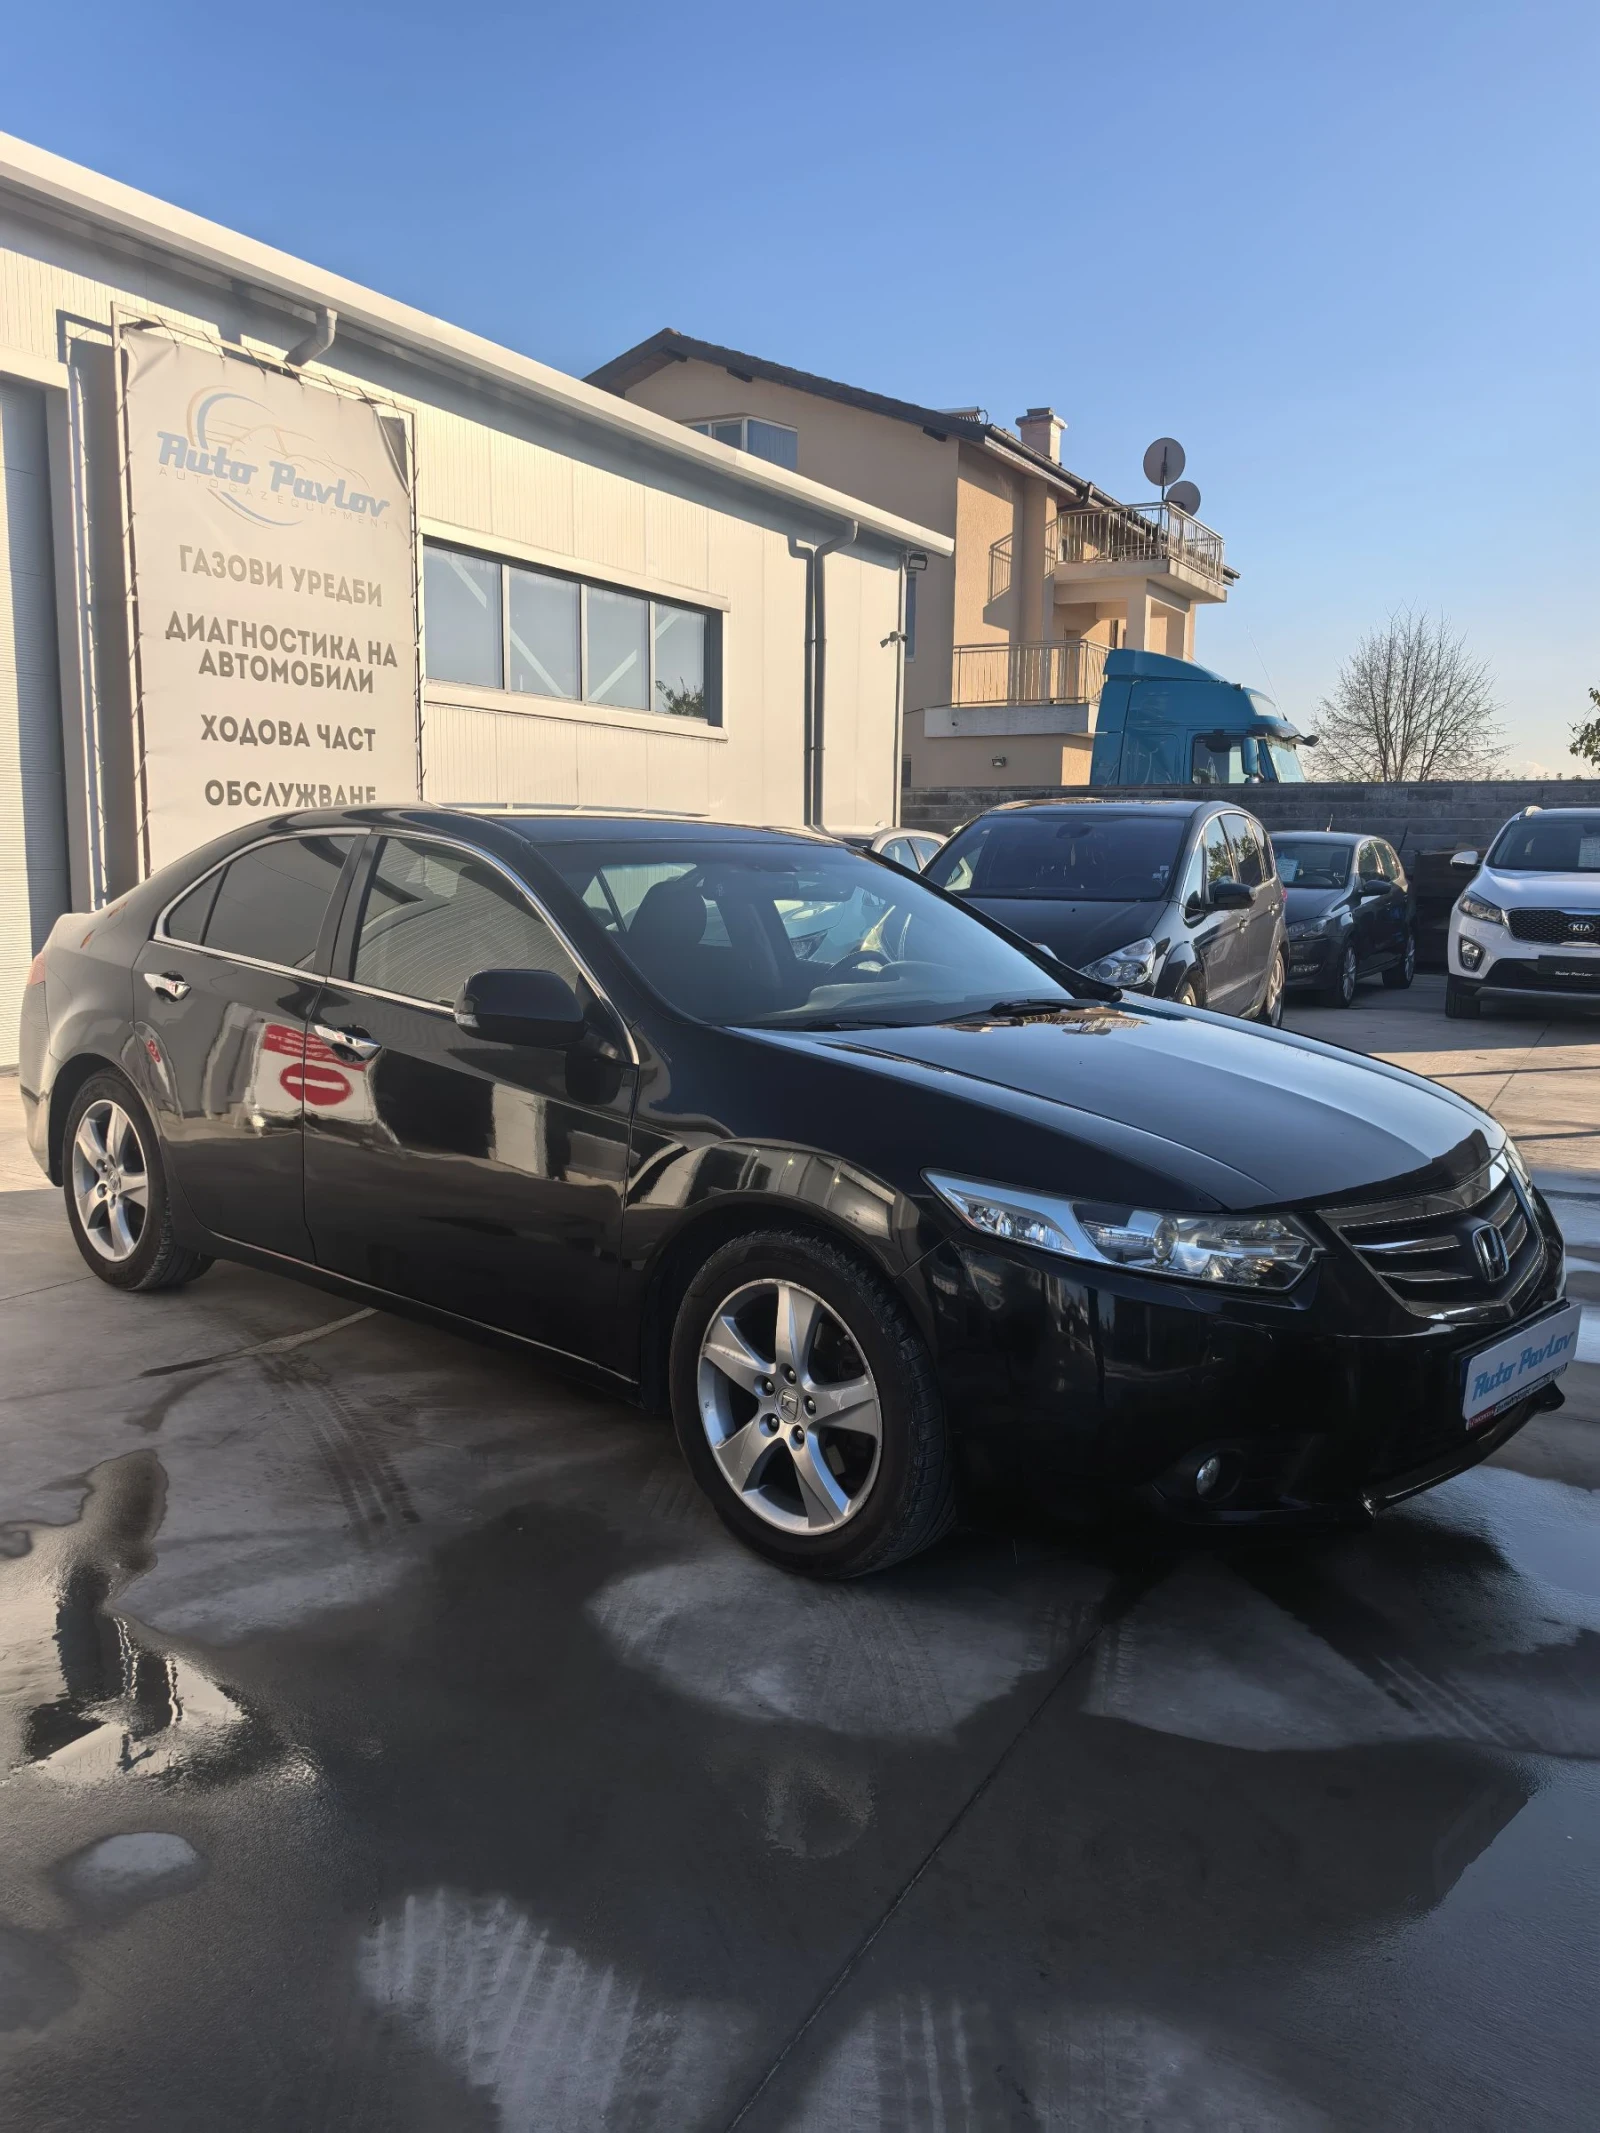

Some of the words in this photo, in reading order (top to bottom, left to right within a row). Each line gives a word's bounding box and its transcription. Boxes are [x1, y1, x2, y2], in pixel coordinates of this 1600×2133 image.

[157, 430, 259, 486] Auto
[269, 459, 391, 518] Pavlov
[179, 544, 283, 590] ГАЗОВИ
[290, 565, 382, 607] УРЕДБИ
[165, 610, 362, 664] ДИАГНОСТИКА
[367, 640, 398, 668] НА
[198, 648, 374, 694] АВТОМОБИЛИ
[200, 714, 310, 748] ХОДОВА
[316, 726, 376, 752] ЧАСТ
[204, 779, 377, 808] ОБСЛУЖВАНЕ
[1572, 923, 1591, 932] KIA
[1472, 1361, 1516, 1401] Auto
[1518, 1331, 1575, 1375] Pavlov
